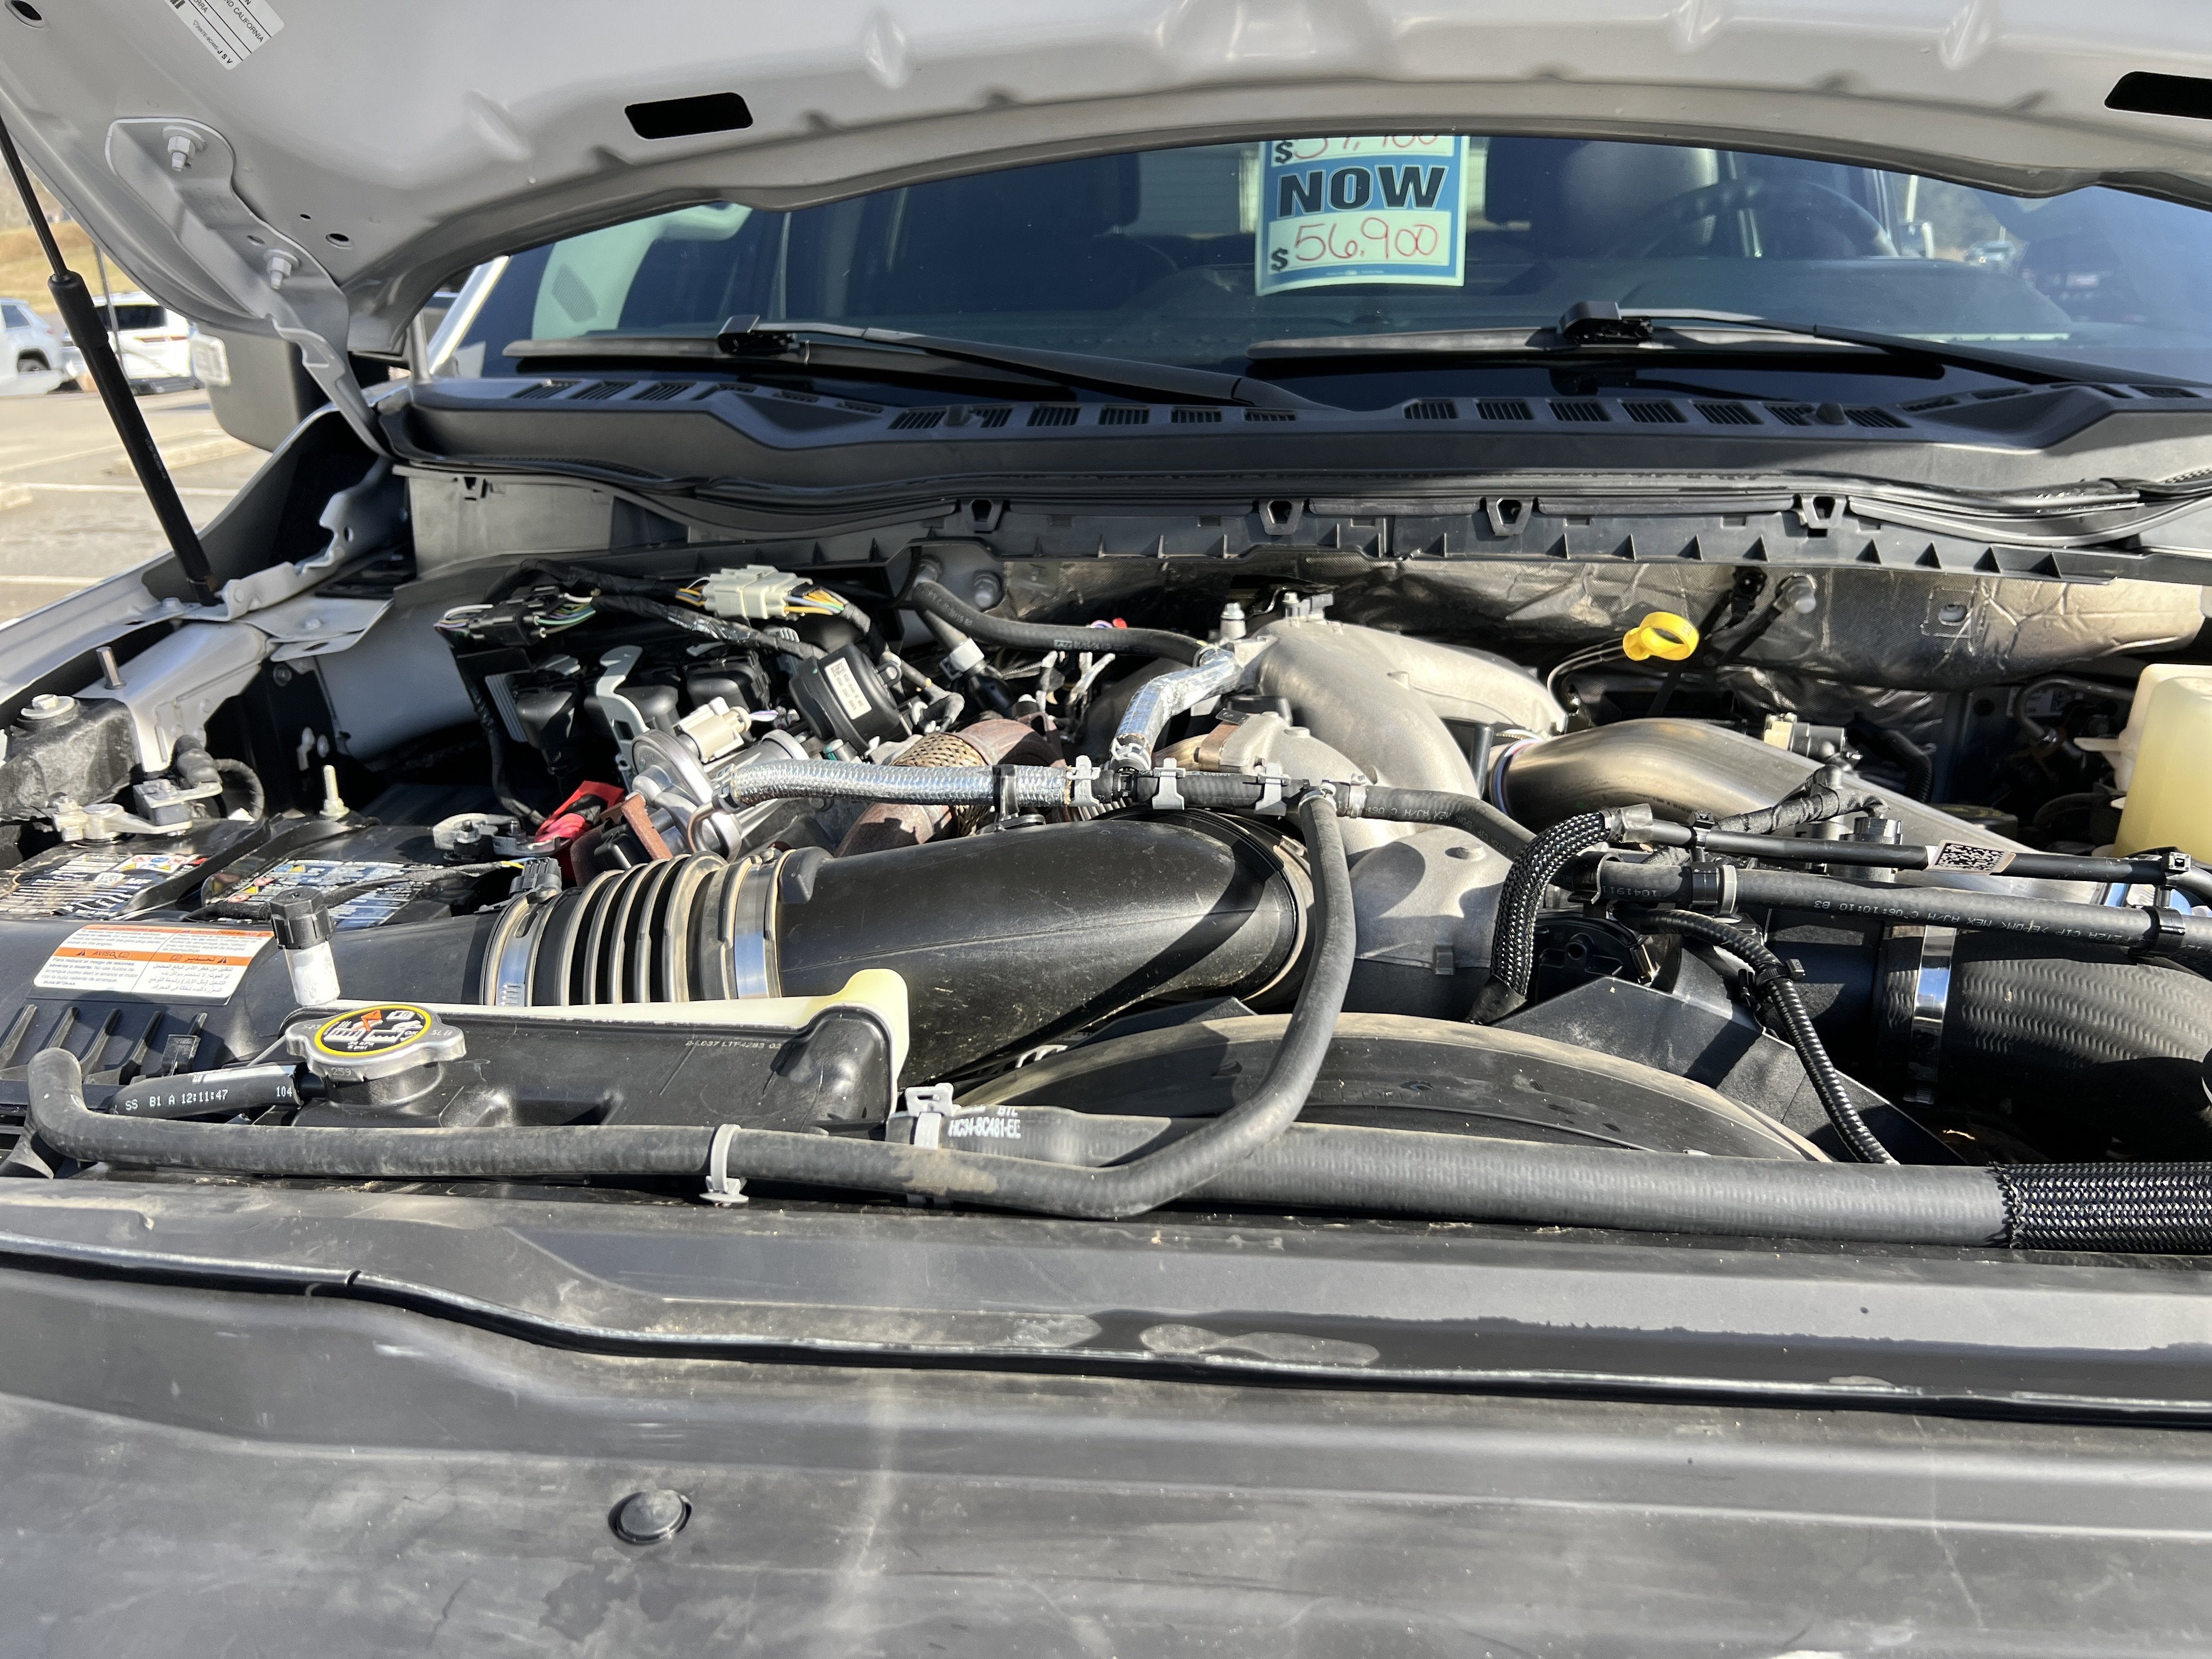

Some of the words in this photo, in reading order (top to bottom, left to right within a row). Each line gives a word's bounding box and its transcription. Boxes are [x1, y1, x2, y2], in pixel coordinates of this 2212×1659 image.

[233, 7, 264, 43] CALIFORNIA
[1278, 165, 1448, 218] NOW
[1404, 809, 1430, 817] AJ/H
[1813, 900, 1831, 909] B3
[1927, 912, 1961, 923] AJ/H
[1966, 917, 1993, 928] MEX
[149, 1096, 161, 1107] B1
[168, 1094, 176, 1105] A
[182, 1089, 228, 1105] 12:11:47
[276, 1086, 292, 1098] 104
